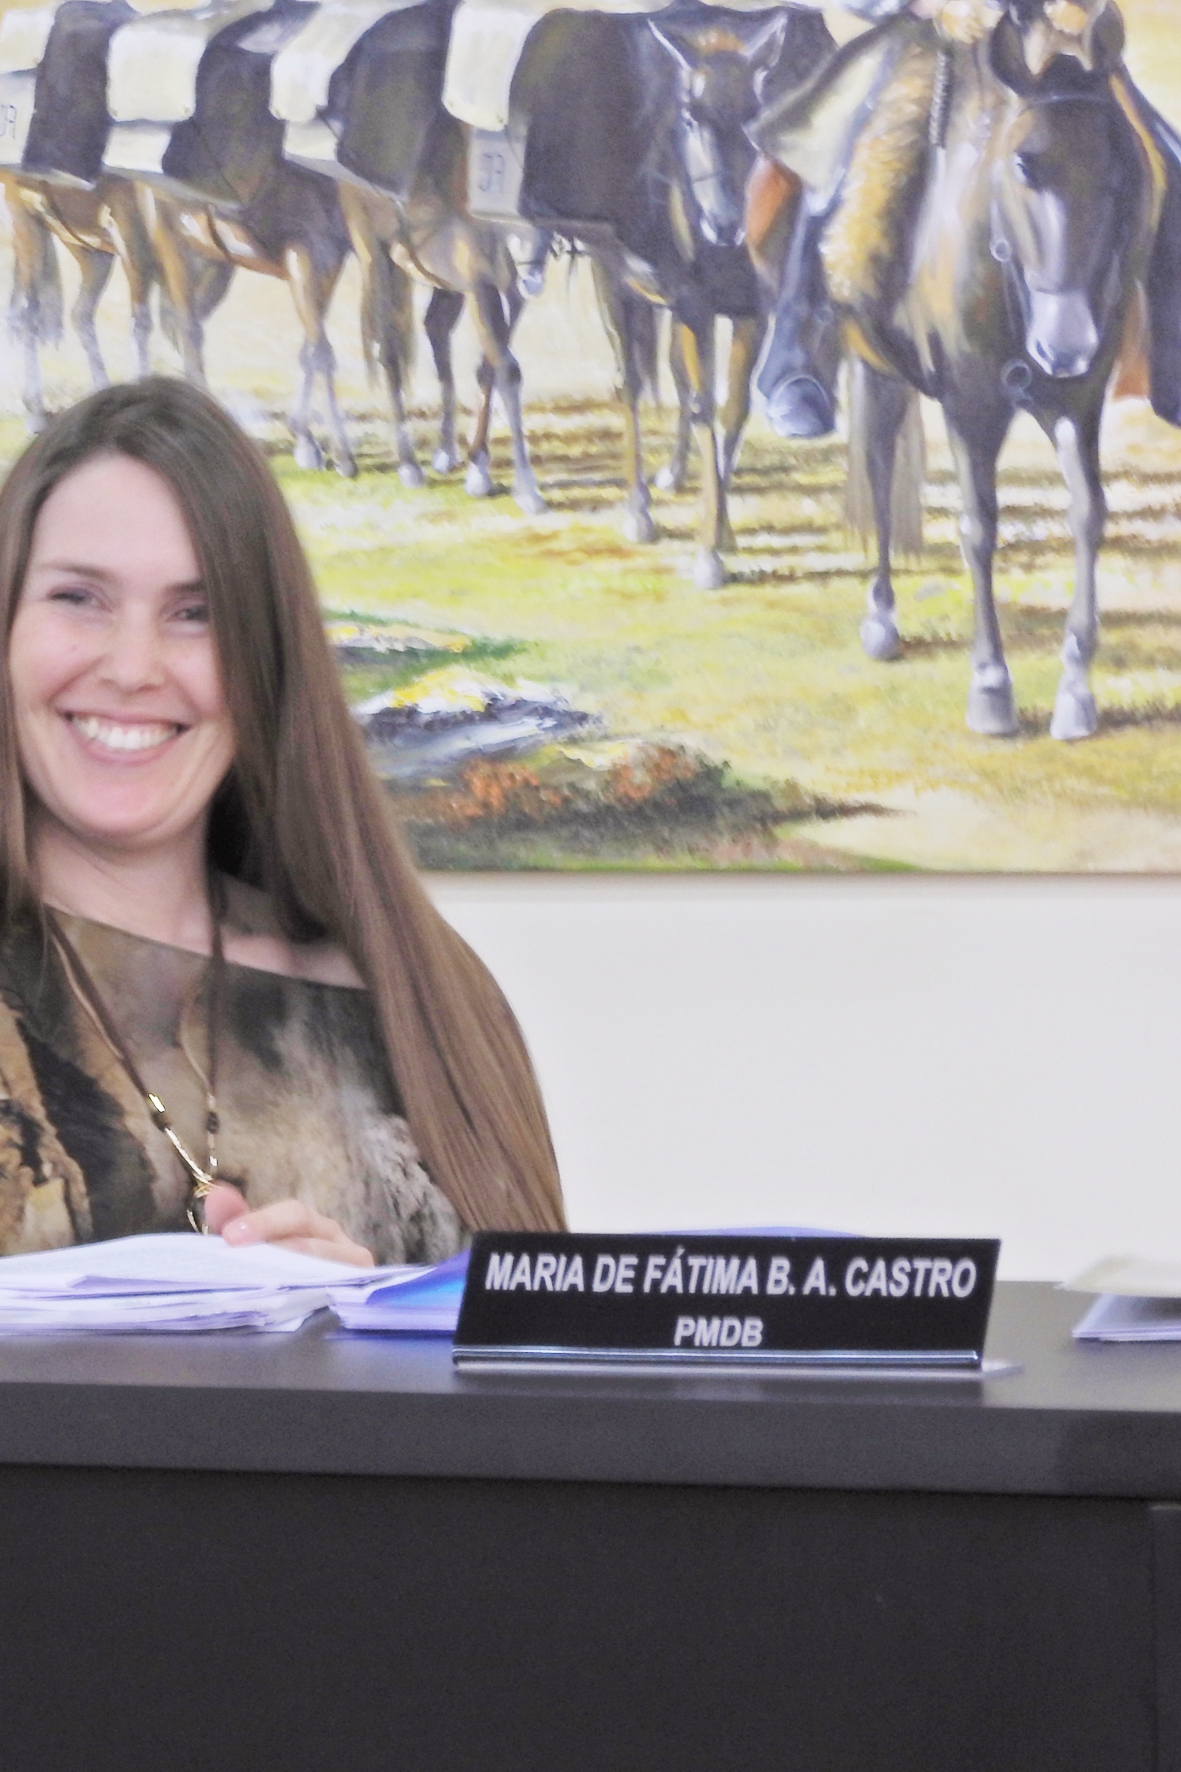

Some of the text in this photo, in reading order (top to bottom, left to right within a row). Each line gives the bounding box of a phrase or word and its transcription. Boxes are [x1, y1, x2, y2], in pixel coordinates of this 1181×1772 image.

[484, 1246, 977, 1298] MARIA DE FÁTIMA B. A. CASTRO
[673, 1316, 764, 1348] PMDB
